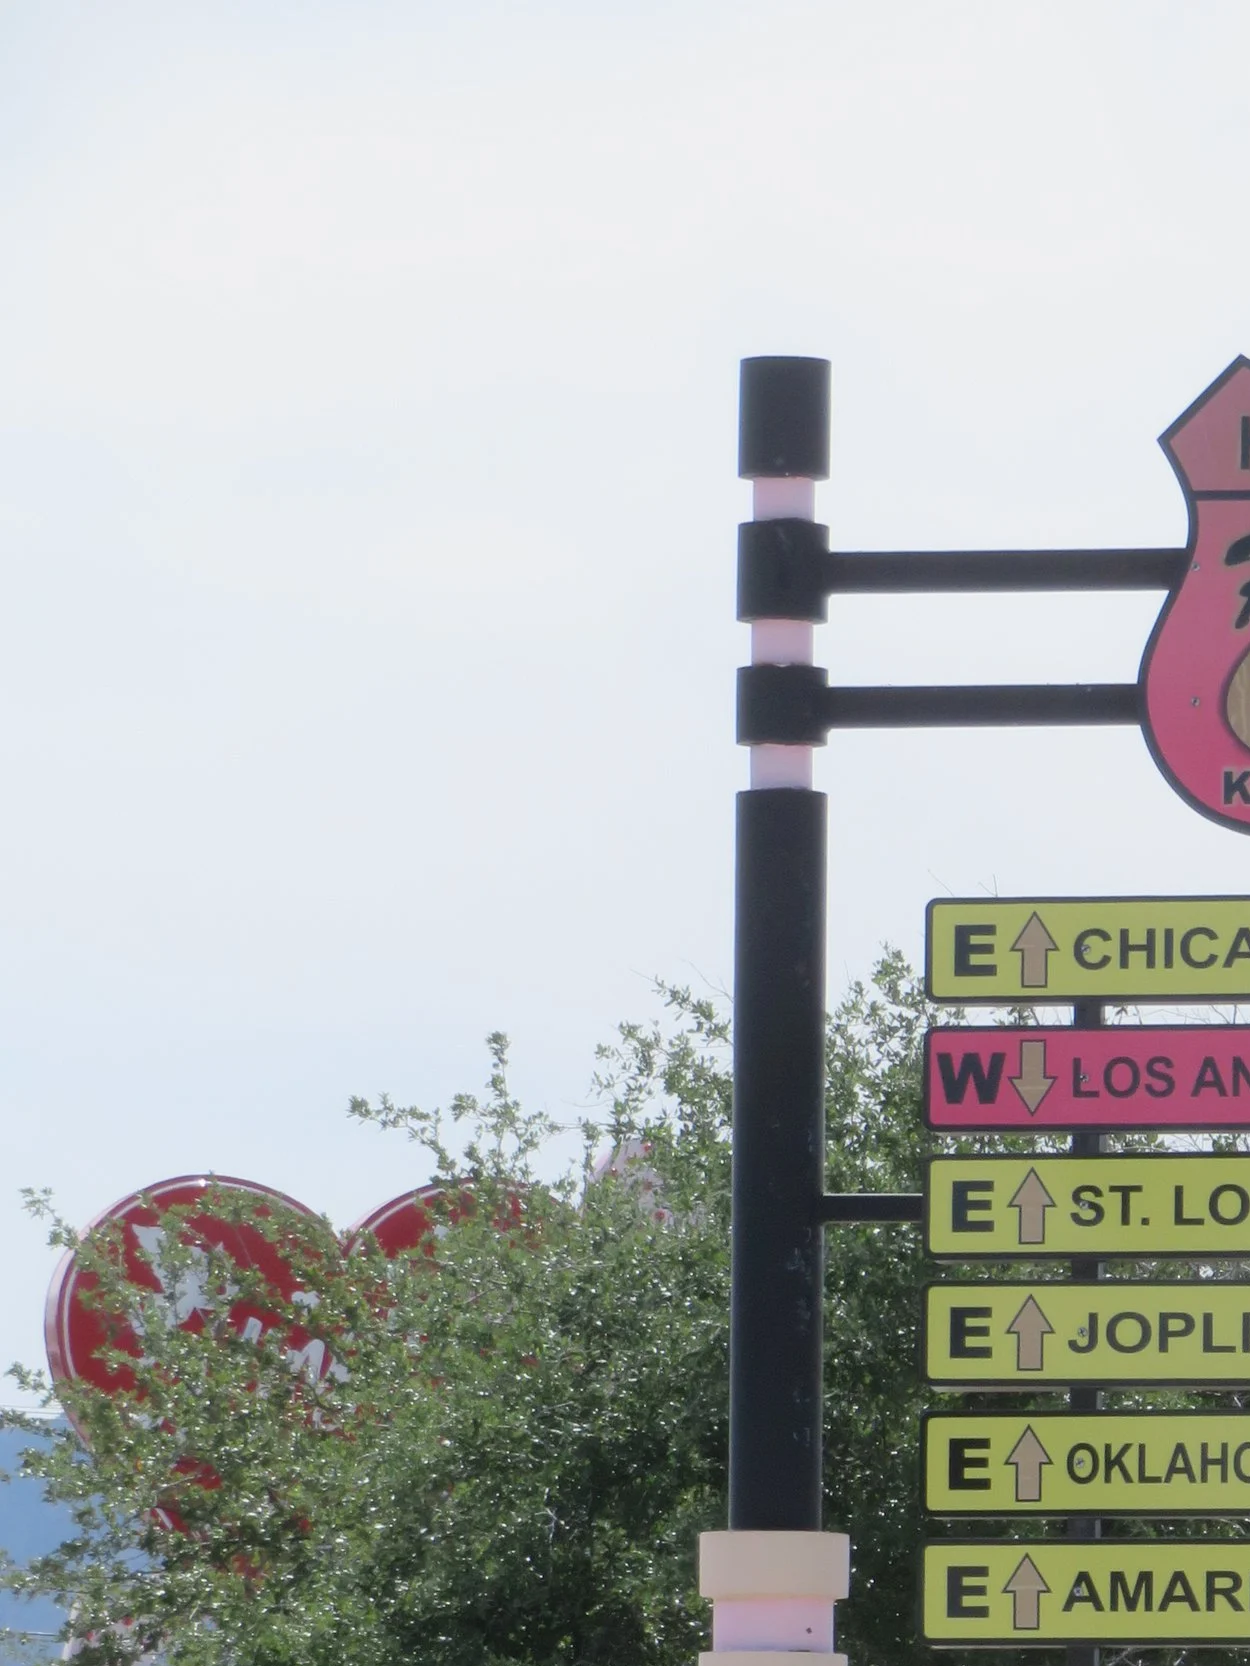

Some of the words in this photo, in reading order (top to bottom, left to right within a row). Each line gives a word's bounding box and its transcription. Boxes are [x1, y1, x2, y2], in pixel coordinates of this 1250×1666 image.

[954, 925, 997, 976] E
[937, 1052, 1006, 1104] W
[1072, 1056, 1175, 1098] LOS
[952, 1181, 994, 1232] E
[1070, 1185, 1149, 1226] ST.
[950, 1307, 992, 1358] E
[949, 1438, 991, 1490] E
[947, 1566, 989, 1618] E
